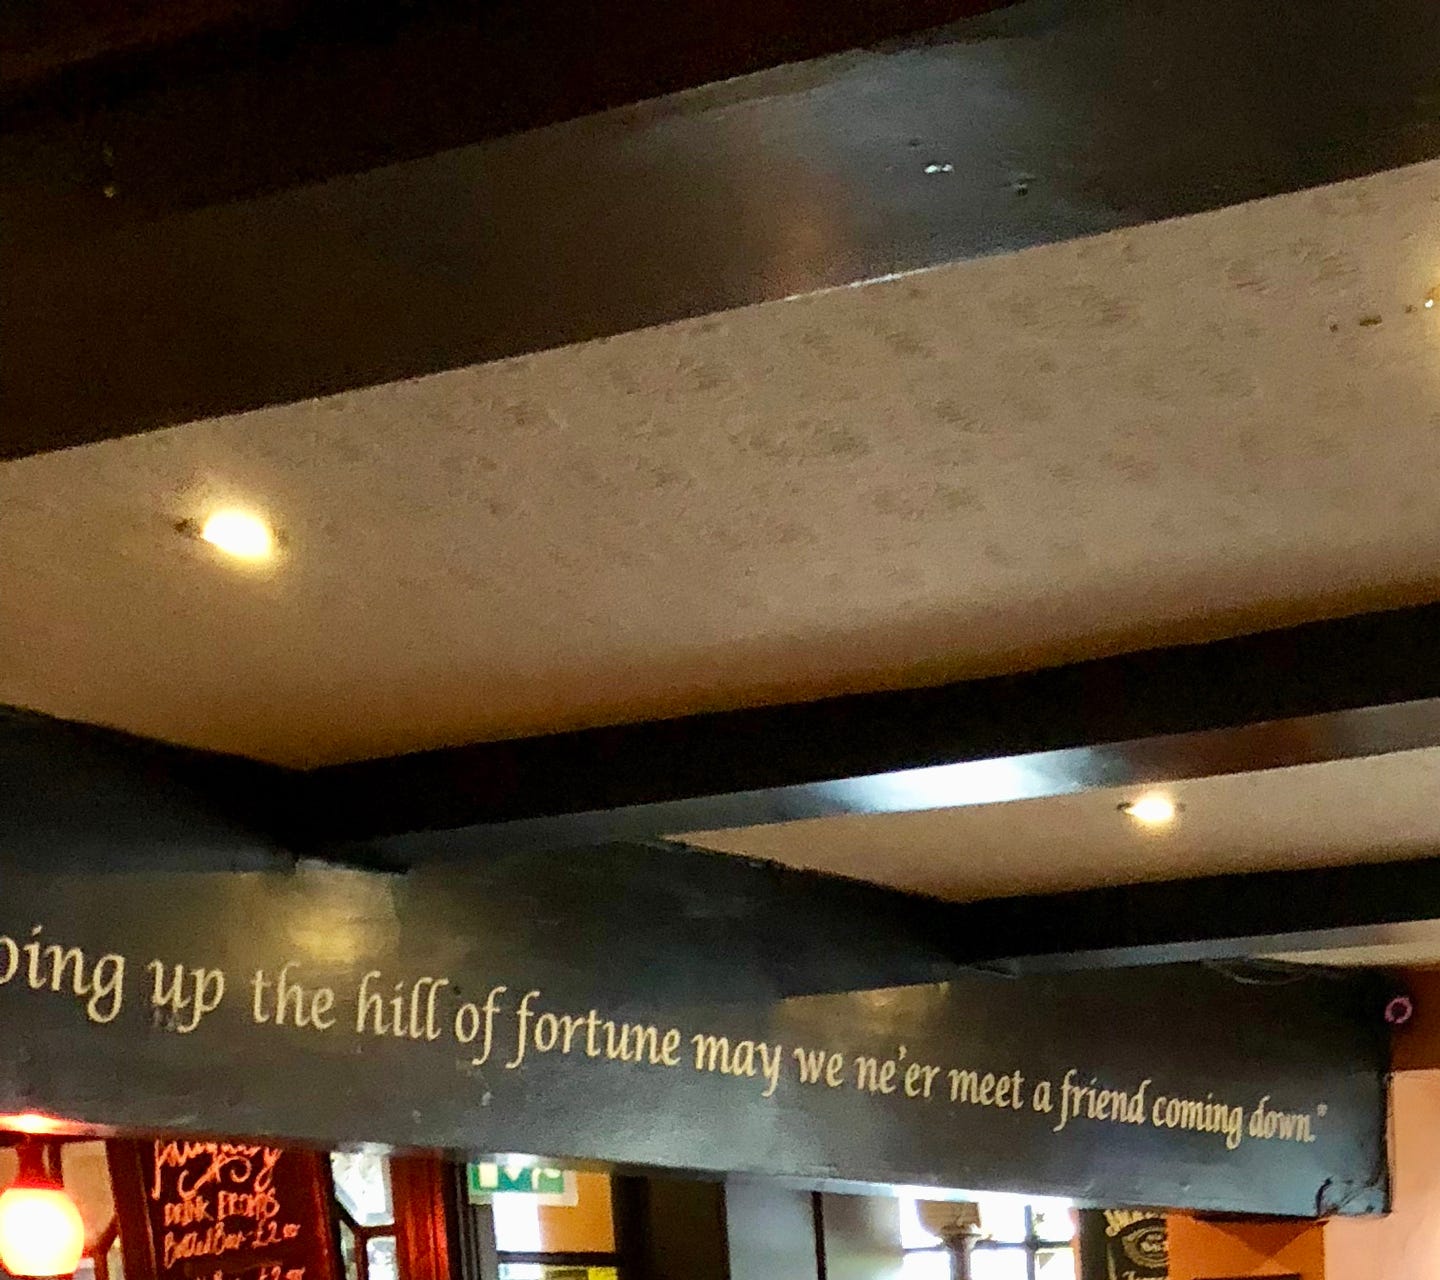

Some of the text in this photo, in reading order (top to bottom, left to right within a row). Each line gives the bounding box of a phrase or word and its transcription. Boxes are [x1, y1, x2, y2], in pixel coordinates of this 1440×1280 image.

[148, 958, 225, 1033] up
[251, 962, 335, 1031] the
[356, 970, 450, 1041] hill
[454, 986, 507, 1066] of
[505, 991, 682, 1069] fortune
[692, 1033, 782, 1097] may
[795, 1045, 844, 1088] we
[857, 1046, 941, 1099] ne'er
[948, 1068, 1024, 1111] meet
[1032, 1080, 1053, 1113] a
[1053, 1069, 1152, 1132] friend
[1152, 1093, 1243, 1150] coming
